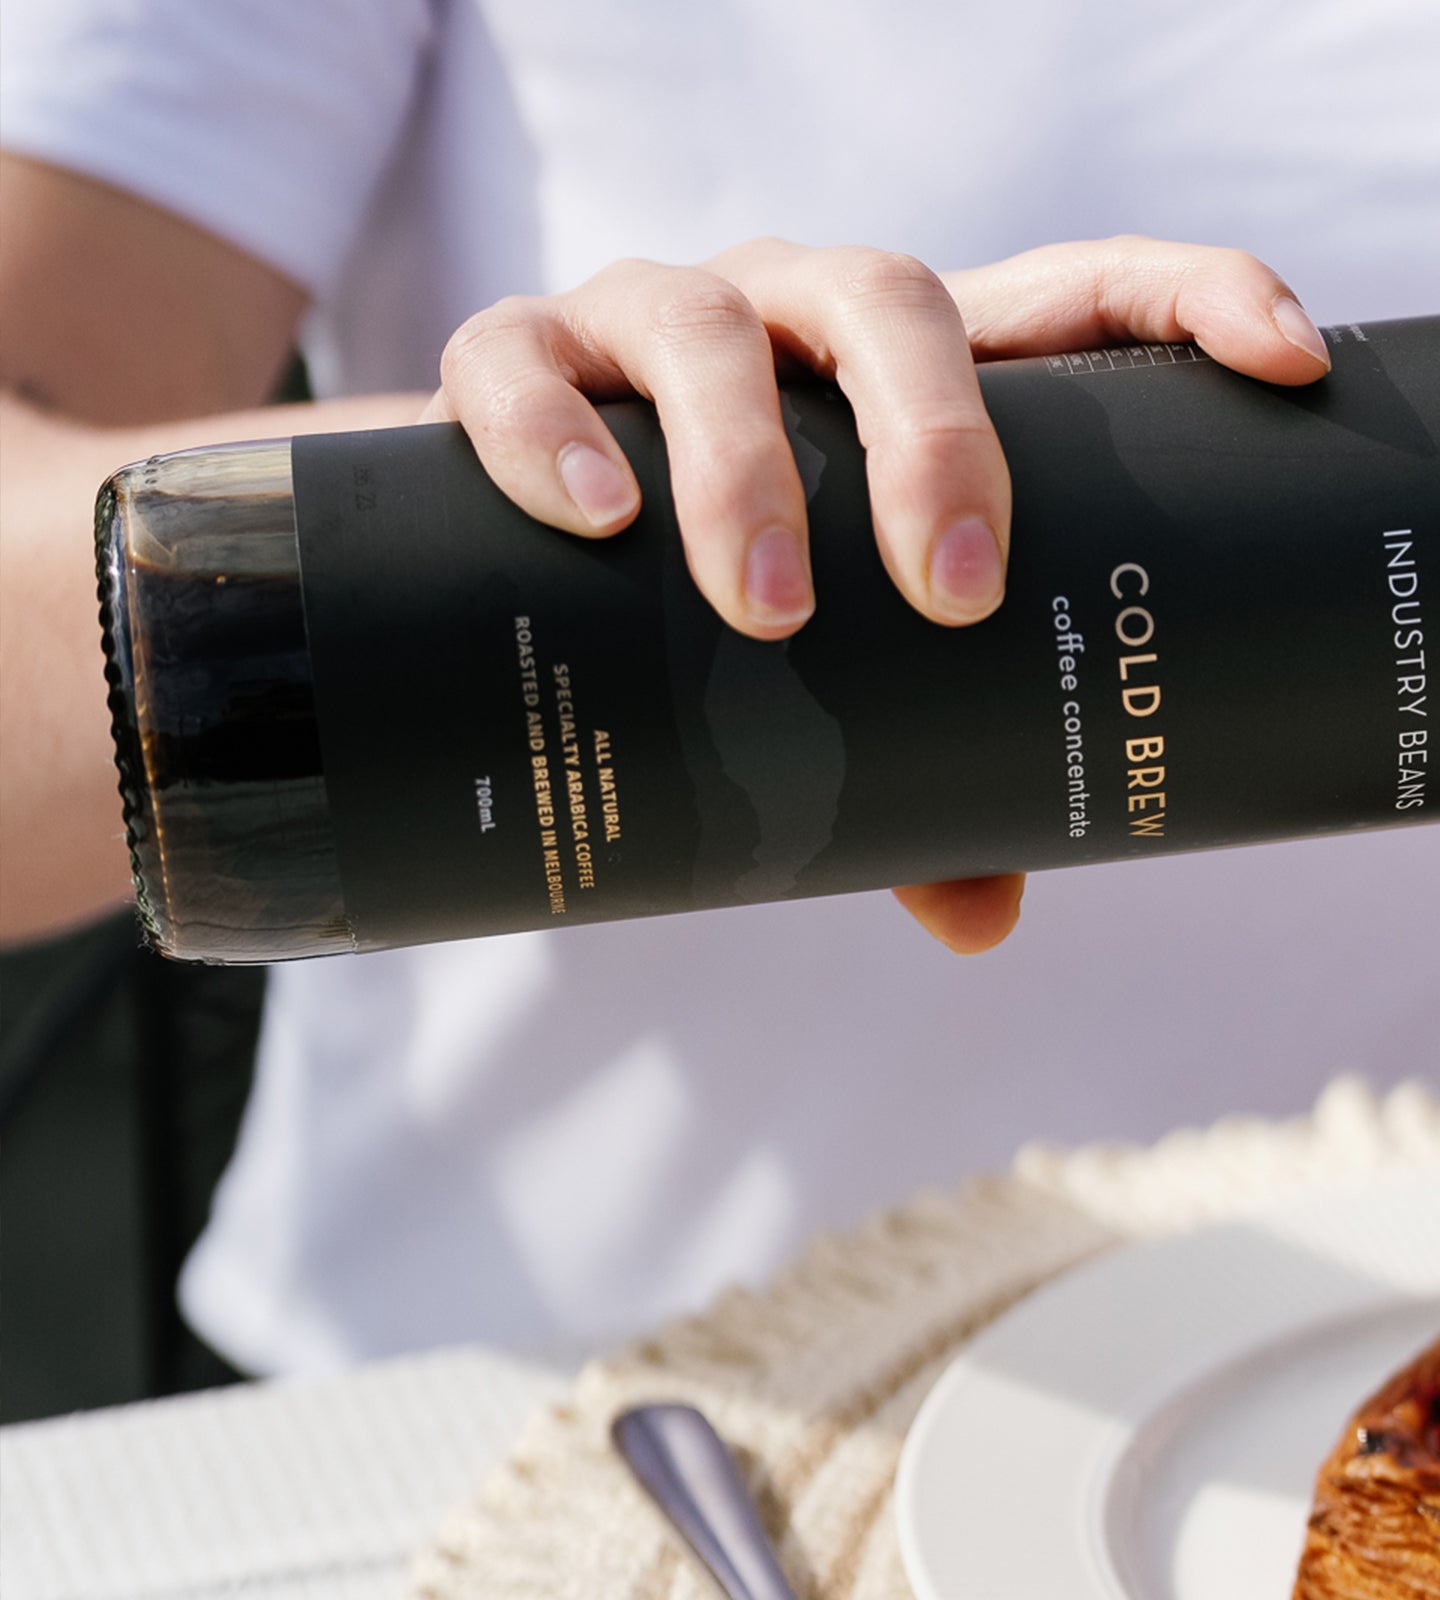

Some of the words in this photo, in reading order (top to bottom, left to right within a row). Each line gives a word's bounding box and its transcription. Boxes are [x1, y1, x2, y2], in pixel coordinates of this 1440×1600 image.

[1052, 596, 1085, 691] coffee
[1110, 562, 1161, 718] COLD
[1383, 529, 1427, 716] INDUSTRY
[515, 616, 540, 707] ROASTED
[526, 711, 545, 751] AND
[553, 663, 580, 766] SPECIALTY
[594, 730, 612, 765] ALL
[475, 776, 496, 833] 700mL
[531, 755, 555, 827] BREWED
[566, 770, 589, 840] ARABICA
[599, 768, 621, 842] NATURAL
[1063, 701, 1091, 839] concentrate
[1126, 736, 1166, 837] BREW
[1396, 730, 1428, 810] BEANS
[541, 830, 557, 847] IN
[575, 843, 595, 889] COFFEE
[543, 850, 566, 914] MELBOURNE
